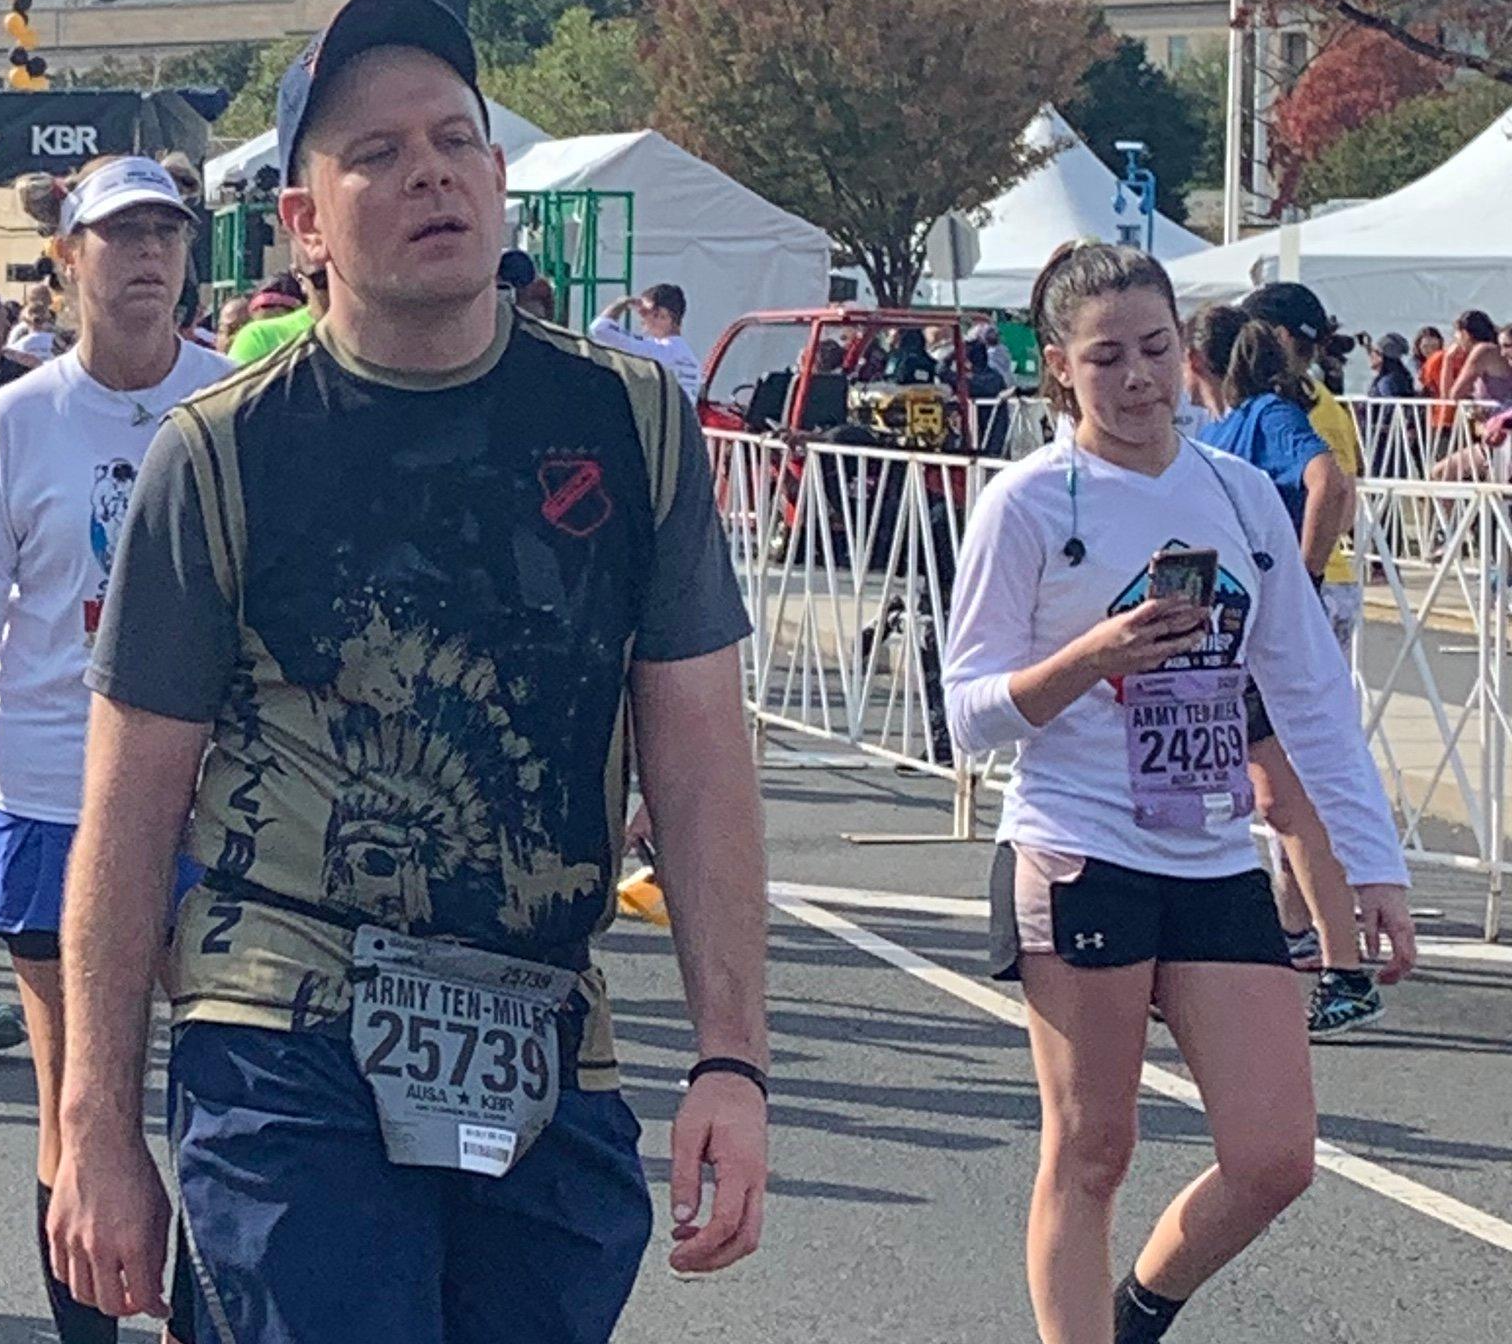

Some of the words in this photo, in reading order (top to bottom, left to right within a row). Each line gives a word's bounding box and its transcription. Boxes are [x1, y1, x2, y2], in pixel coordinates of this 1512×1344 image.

[31, 125, 100, 156] KBR
[1133, 704, 1179, 729] ARMY
[1140, 724, 1245, 776] 24269
[500, 965, 552, 989] 25739
[362, 974, 431, 1013] ARMY
[365, 1009, 549, 1102] 25739
[406, 1083, 449, 1105] AUSA
